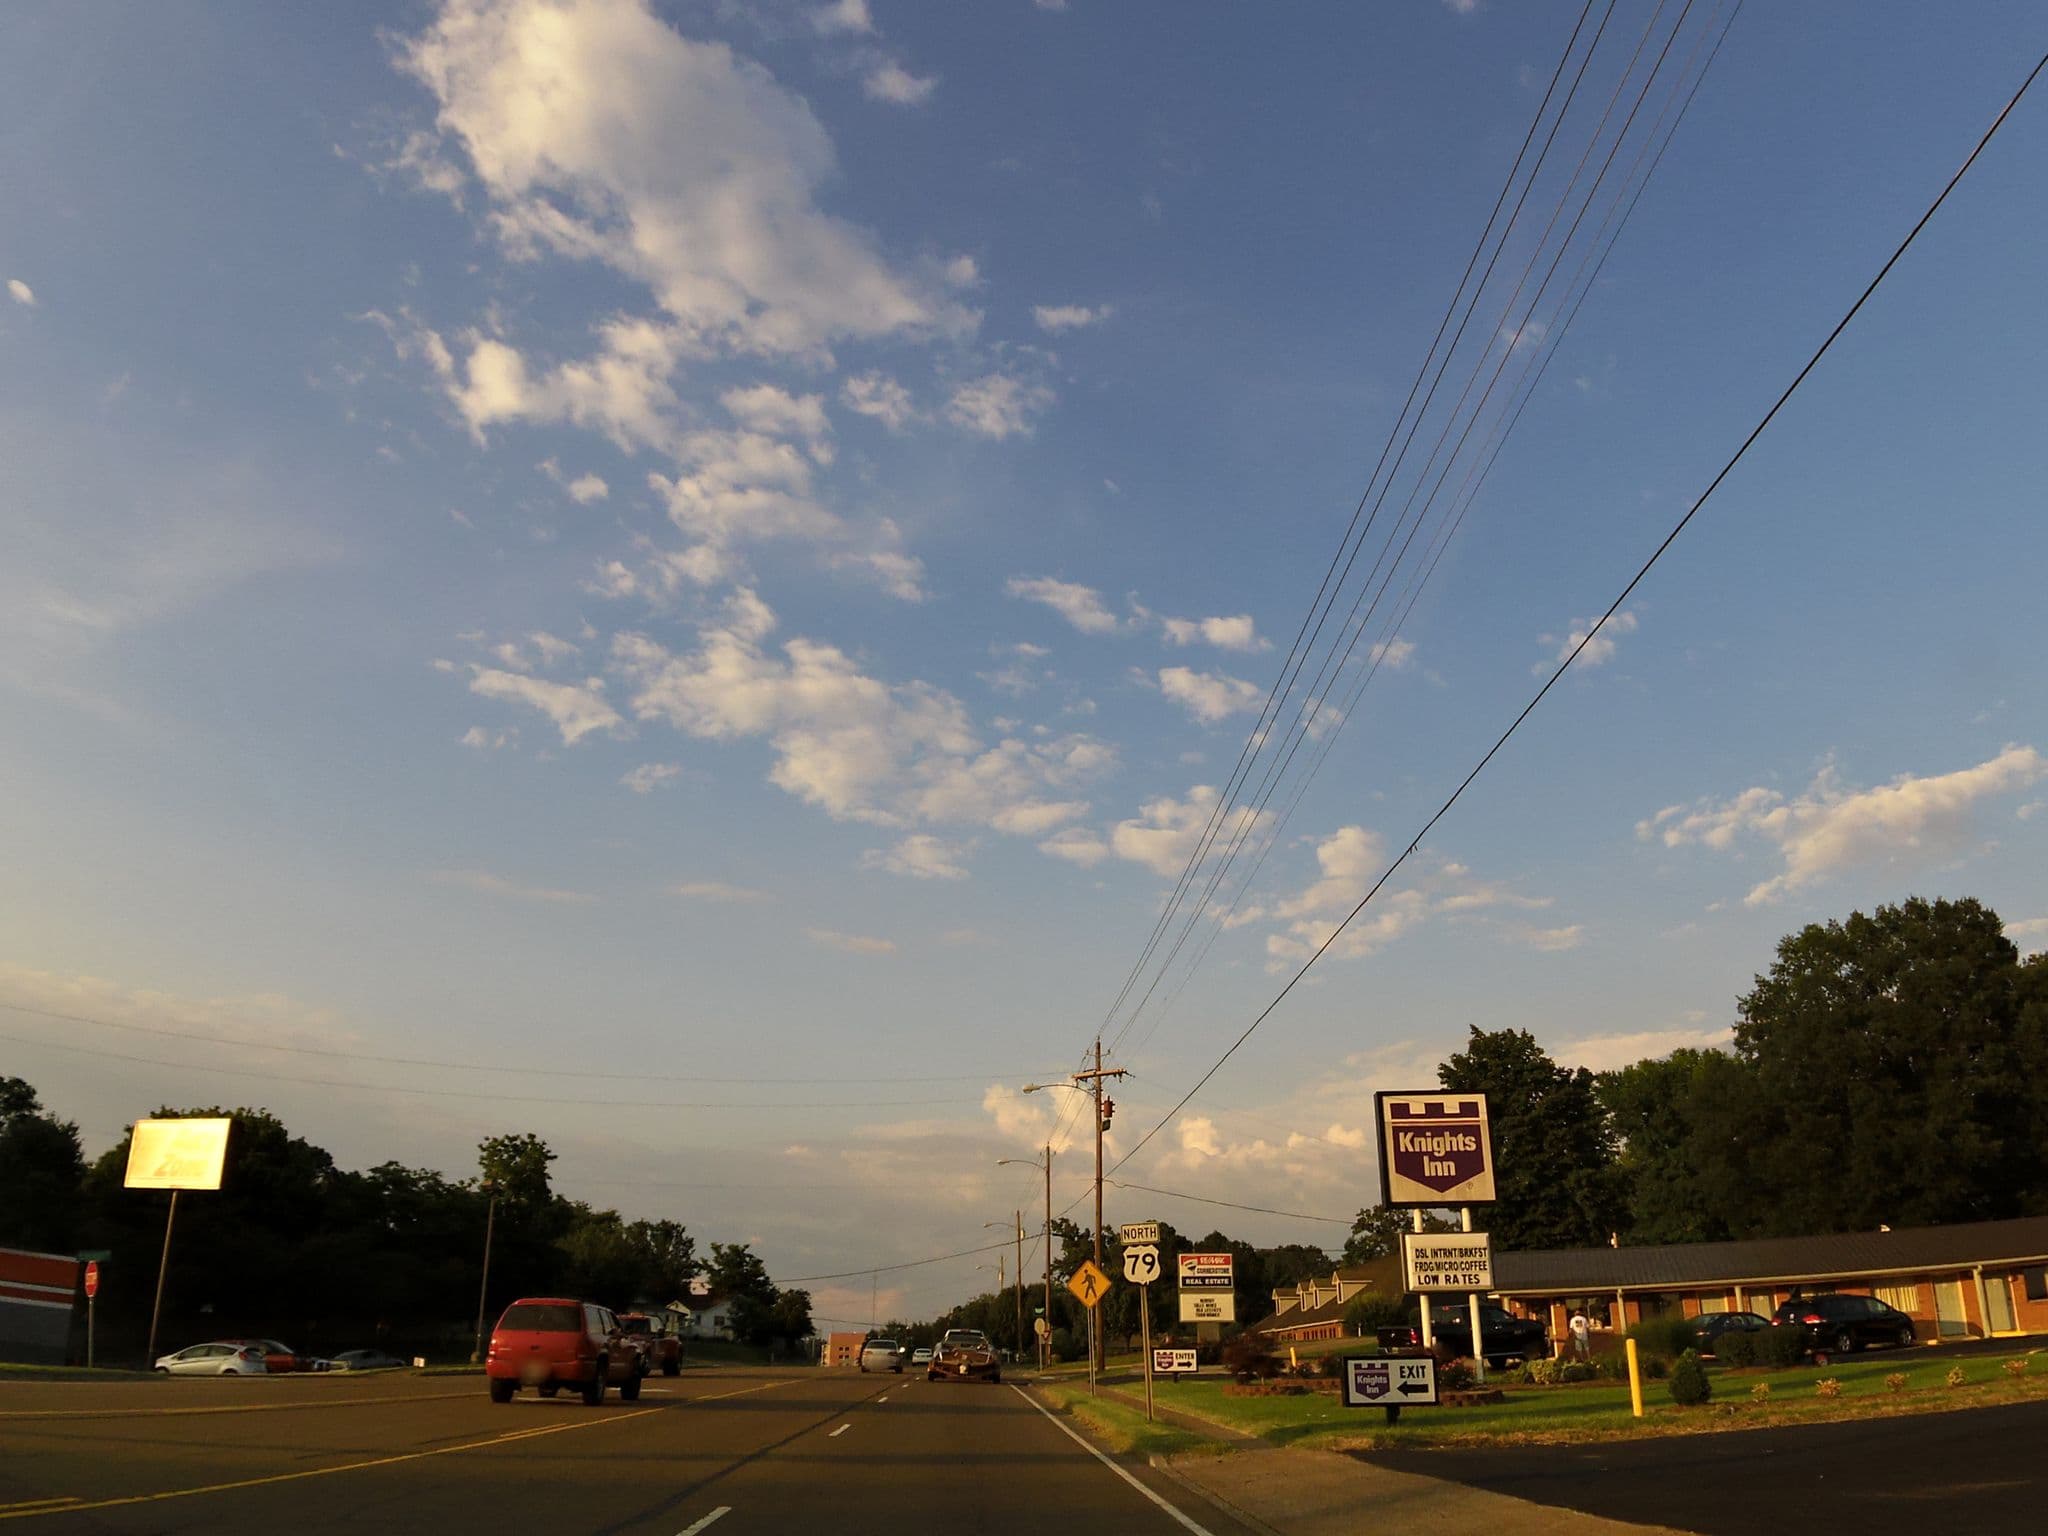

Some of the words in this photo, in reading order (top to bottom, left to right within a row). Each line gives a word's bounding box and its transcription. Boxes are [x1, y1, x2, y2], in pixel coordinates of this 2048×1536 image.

[1398, 1131, 1477, 1157] Knights
[1423, 1155, 1457, 1177] Inn
[1123, 1227, 1157, 1240] NORTH
[1415, 1247, 1429, 1259] DSL
[1127, 1253, 1156, 1275] 79
[1459, 1260, 1488, 1271] COFFEE
[1417, 1274, 1440, 1286] LOW
[1175, 1352, 1194, 1360] ENTER
[1399, 1365, 1426, 1379] EXIT
[1357, 1375, 1388, 1386] Knights
[1366, 1385, 1380, 1394] Inn
